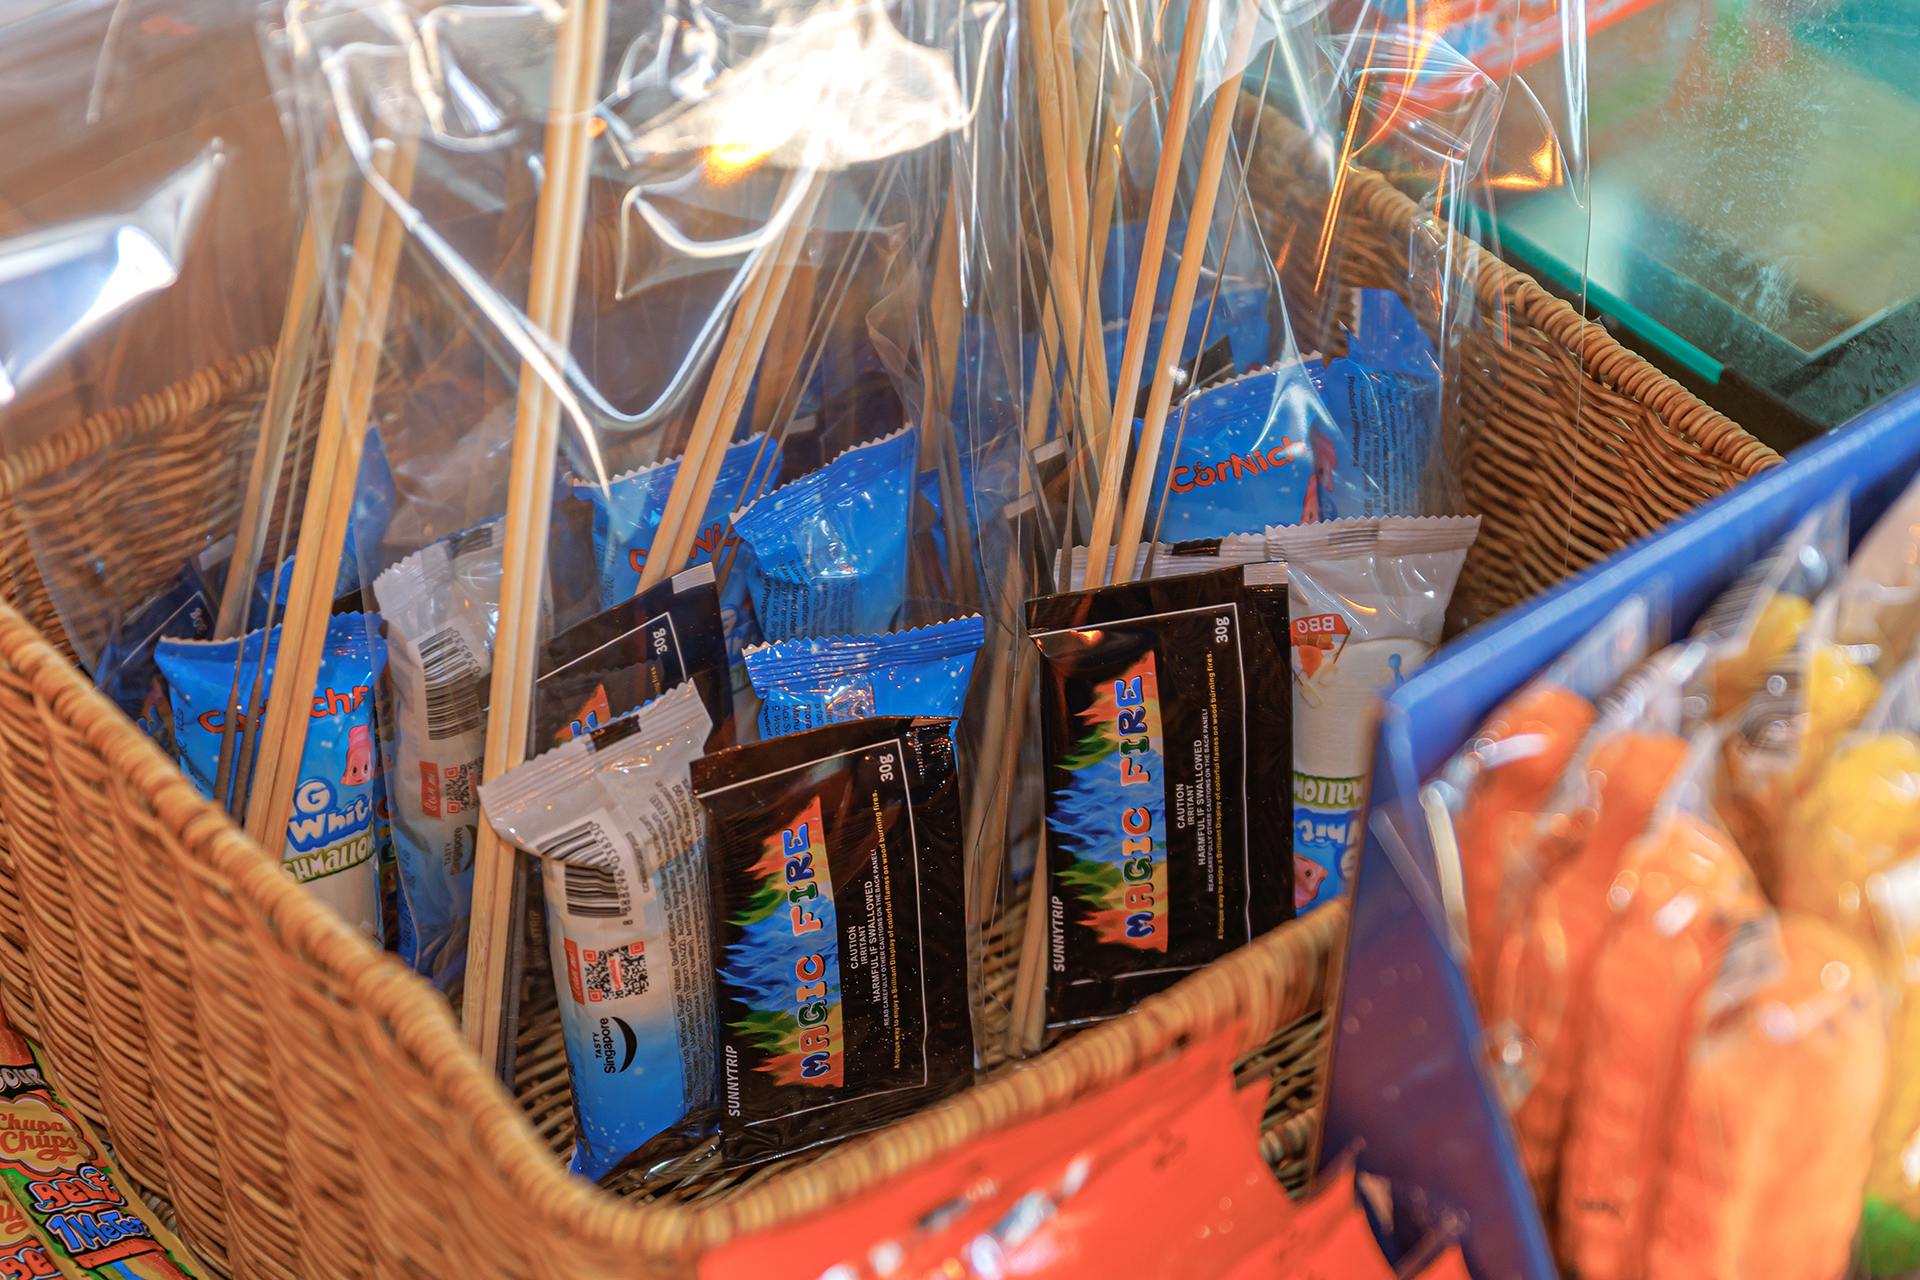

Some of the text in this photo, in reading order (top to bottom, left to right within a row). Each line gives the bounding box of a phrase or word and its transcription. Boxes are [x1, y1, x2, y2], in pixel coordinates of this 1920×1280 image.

[1214, 616, 1230, 644] 30g
[1296, 616, 1334, 634] BBQ
[652, 628, 668, 654] 30g
[1205, 650, 1214, 672] fires.
[1208, 672, 1217, 703] burning
[803, 704, 813, 730] Stora
[1201, 708, 1209, 733] PANEL!
[1210, 703, 1218, 725] wood
[1212, 725, 1219, 736] on
[1212, 736, 1220, 762] flames
[878, 753, 894, 782] 30g
[1204, 767, 1211, 778] ON
[1213, 762, 1221, 792] colorful
[870, 789, 880, 811] fires.
[1114, 676, 1155, 939] MAGIC FIRE
[1175, 783, 1186, 829] CAUTION
[1186, 784, 1195, 826] IRRITANT
[1193, 739, 1206, 866] HARMFUL IF SWALLOWED
[1214, 792, 1221, 800] of
[875, 811, 886, 843] burning
[444, 842, 452, 866] TASTY
[870, 848, 879, 874] PANEL!
[879, 843, 888, 864] wood
[1206, 836, 1214, 873] CAREFULLY
[873, 874, 881, 893] BACK
[882, 865, 889, 875] on
[1216, 865, 1225, 885] enjoy
[883, 876, 891, 900] flames
[1217, 885, 1224, 894] to
[876, 907, 884, 916] ON
[884, 901, 894, 930] colorful
[858, 925, 868, 965] IRRITANT
[864, 881, 881, 1002] HARMFUL IF SWALLOWED
[878, 917, 886, 950] CAUTIONS
[888, 930, 895, 938] of
[1050, 895, 1066, 972] SUNNYTRIP
[782, 821, 830, 1079] MAGIC FIRE
[848, 926, 859, 969] CAUTION
[888, 938, 897, 965] Display
[882, 973, 890, 1008] CAREFULLY
[890, 965, 898, 994] Brilliant
[892, 999, 900, 1019] enjoy
[592, 1032, 603, 1059] TASTY
[599, 1018, 616, 1074] Singapore
[725, 1045, 740, 1117] SUNNYTRIP
[0, 1113, 67, 1135] Chupa
[0, 1131, 78, 1161] Chups
